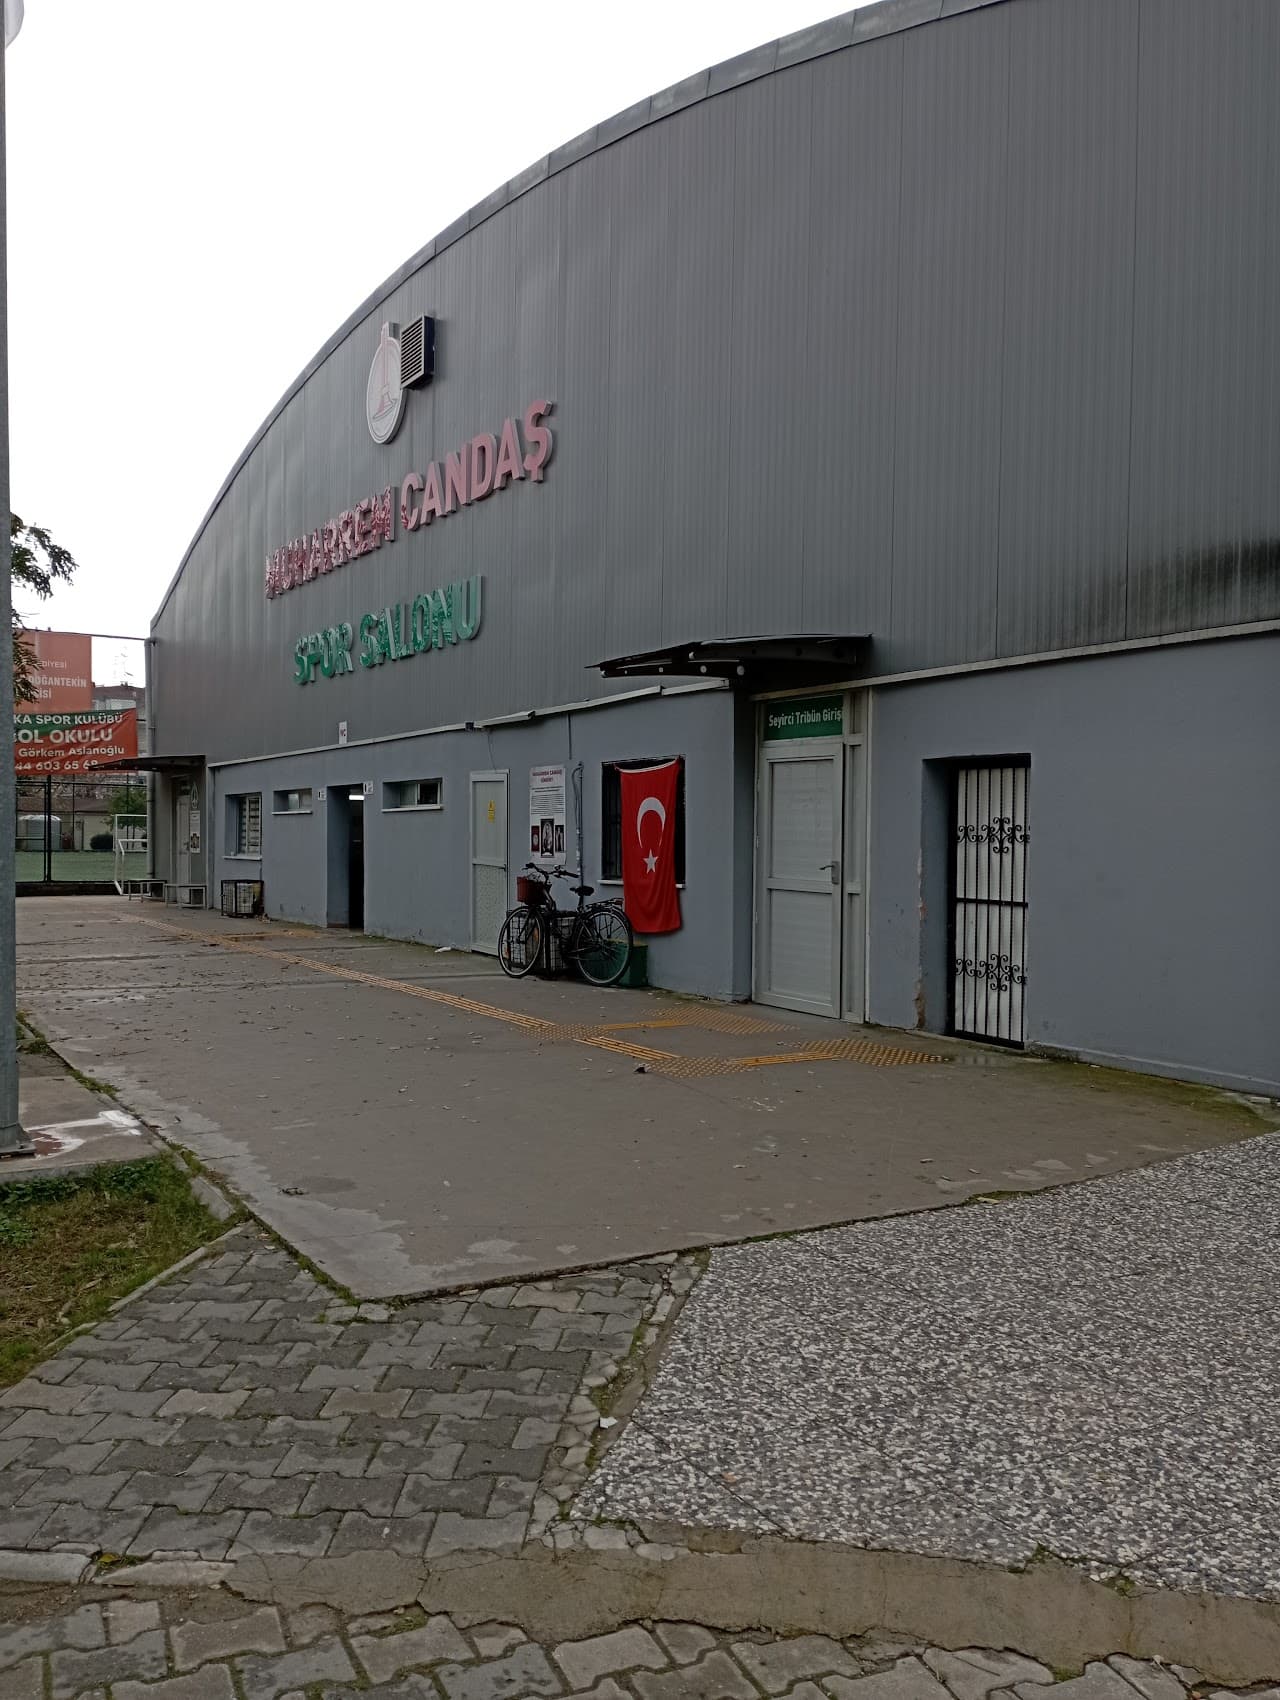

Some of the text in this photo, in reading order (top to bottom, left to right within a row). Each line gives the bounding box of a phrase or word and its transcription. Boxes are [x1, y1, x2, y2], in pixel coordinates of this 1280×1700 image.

[265, 400, 554, 600] MUHARREM CANDAŞ
[294, 575, 483, 684] SPOR SALONU
[14, 712, 123, 725] KA SPOR KULÜBÜ
[768, 711, 794, 728] Seyirci
[795, 709, 821, 724] Tribün
[49, 728, 113, 743] OKULU
[18, 746, 125, 757] Görkem Aslanoğlu
[35, 761, 60, 770] 603
[64, 761, 79, 770] 65
